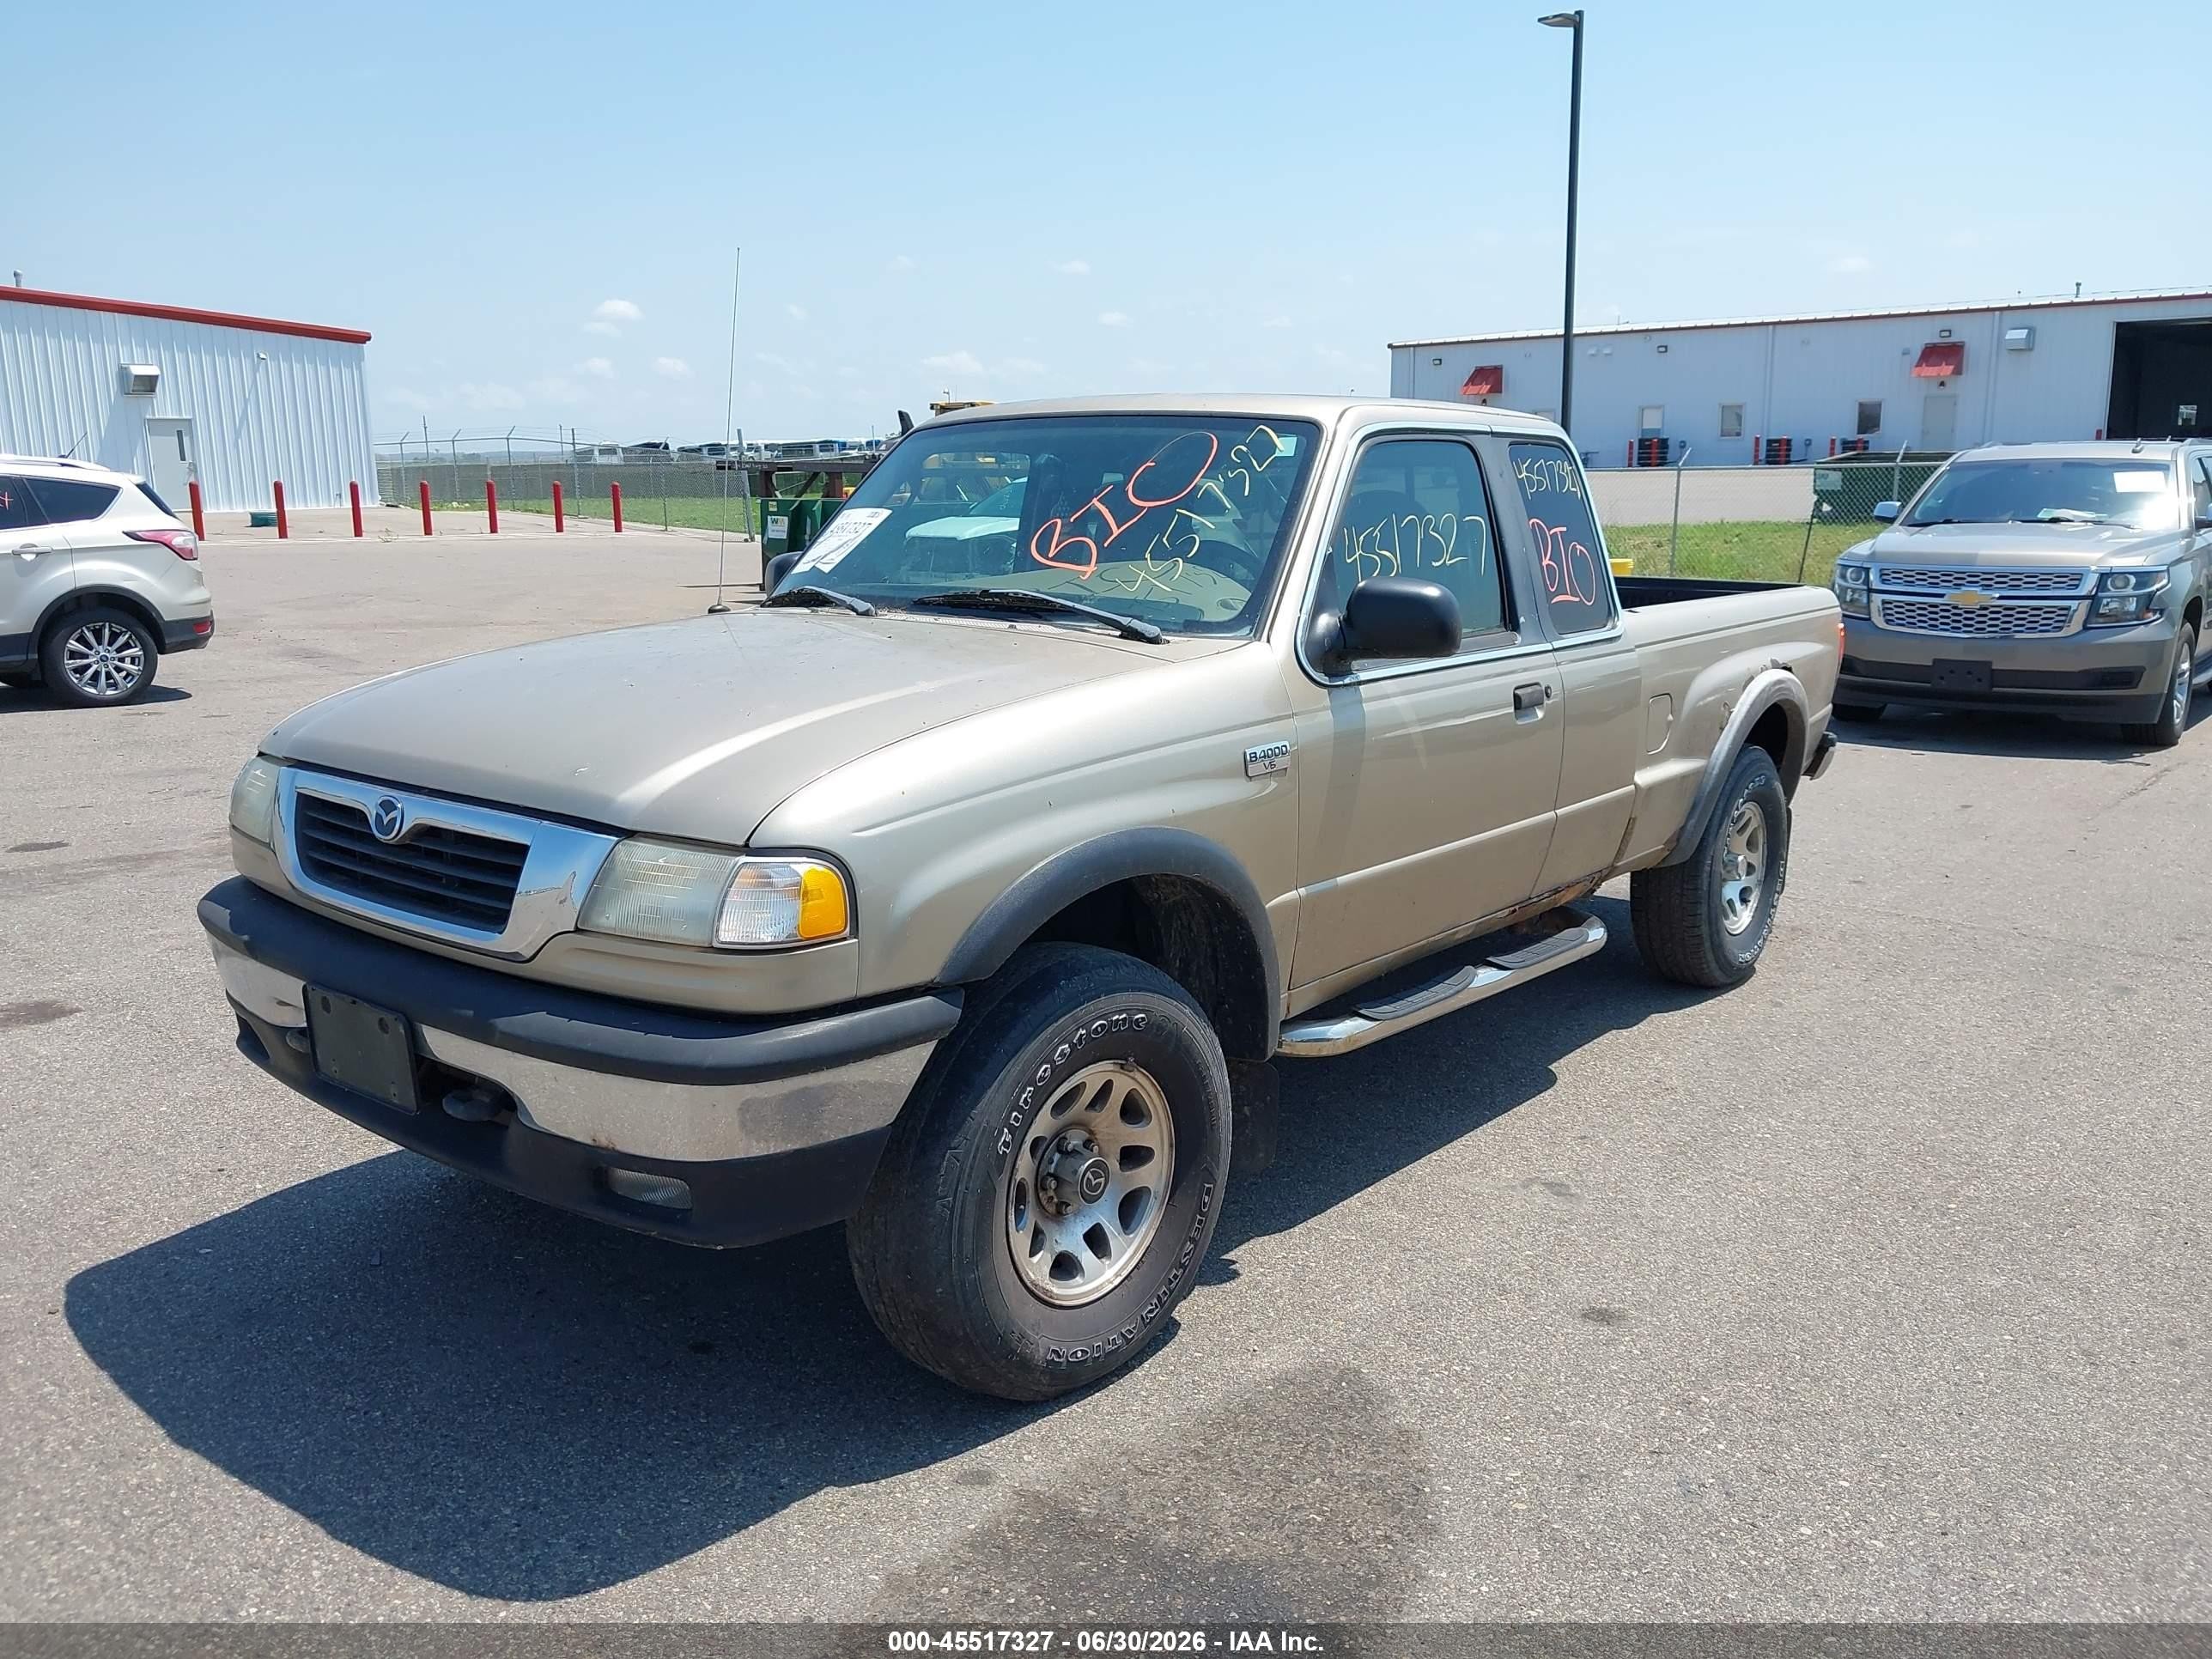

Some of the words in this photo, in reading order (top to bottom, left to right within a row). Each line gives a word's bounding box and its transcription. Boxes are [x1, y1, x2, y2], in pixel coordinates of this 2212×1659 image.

[1343, 514, 1486, 582] 45517327
[1528, 518, 1596, 605] BIO
[1249, 744, 1289, 763] B4000
[1263, 760, 1277, 771] V6
[996, 1012, 1149, 1156] Firestone
[1046, 1182, 1214, 1364] DESTINATION
